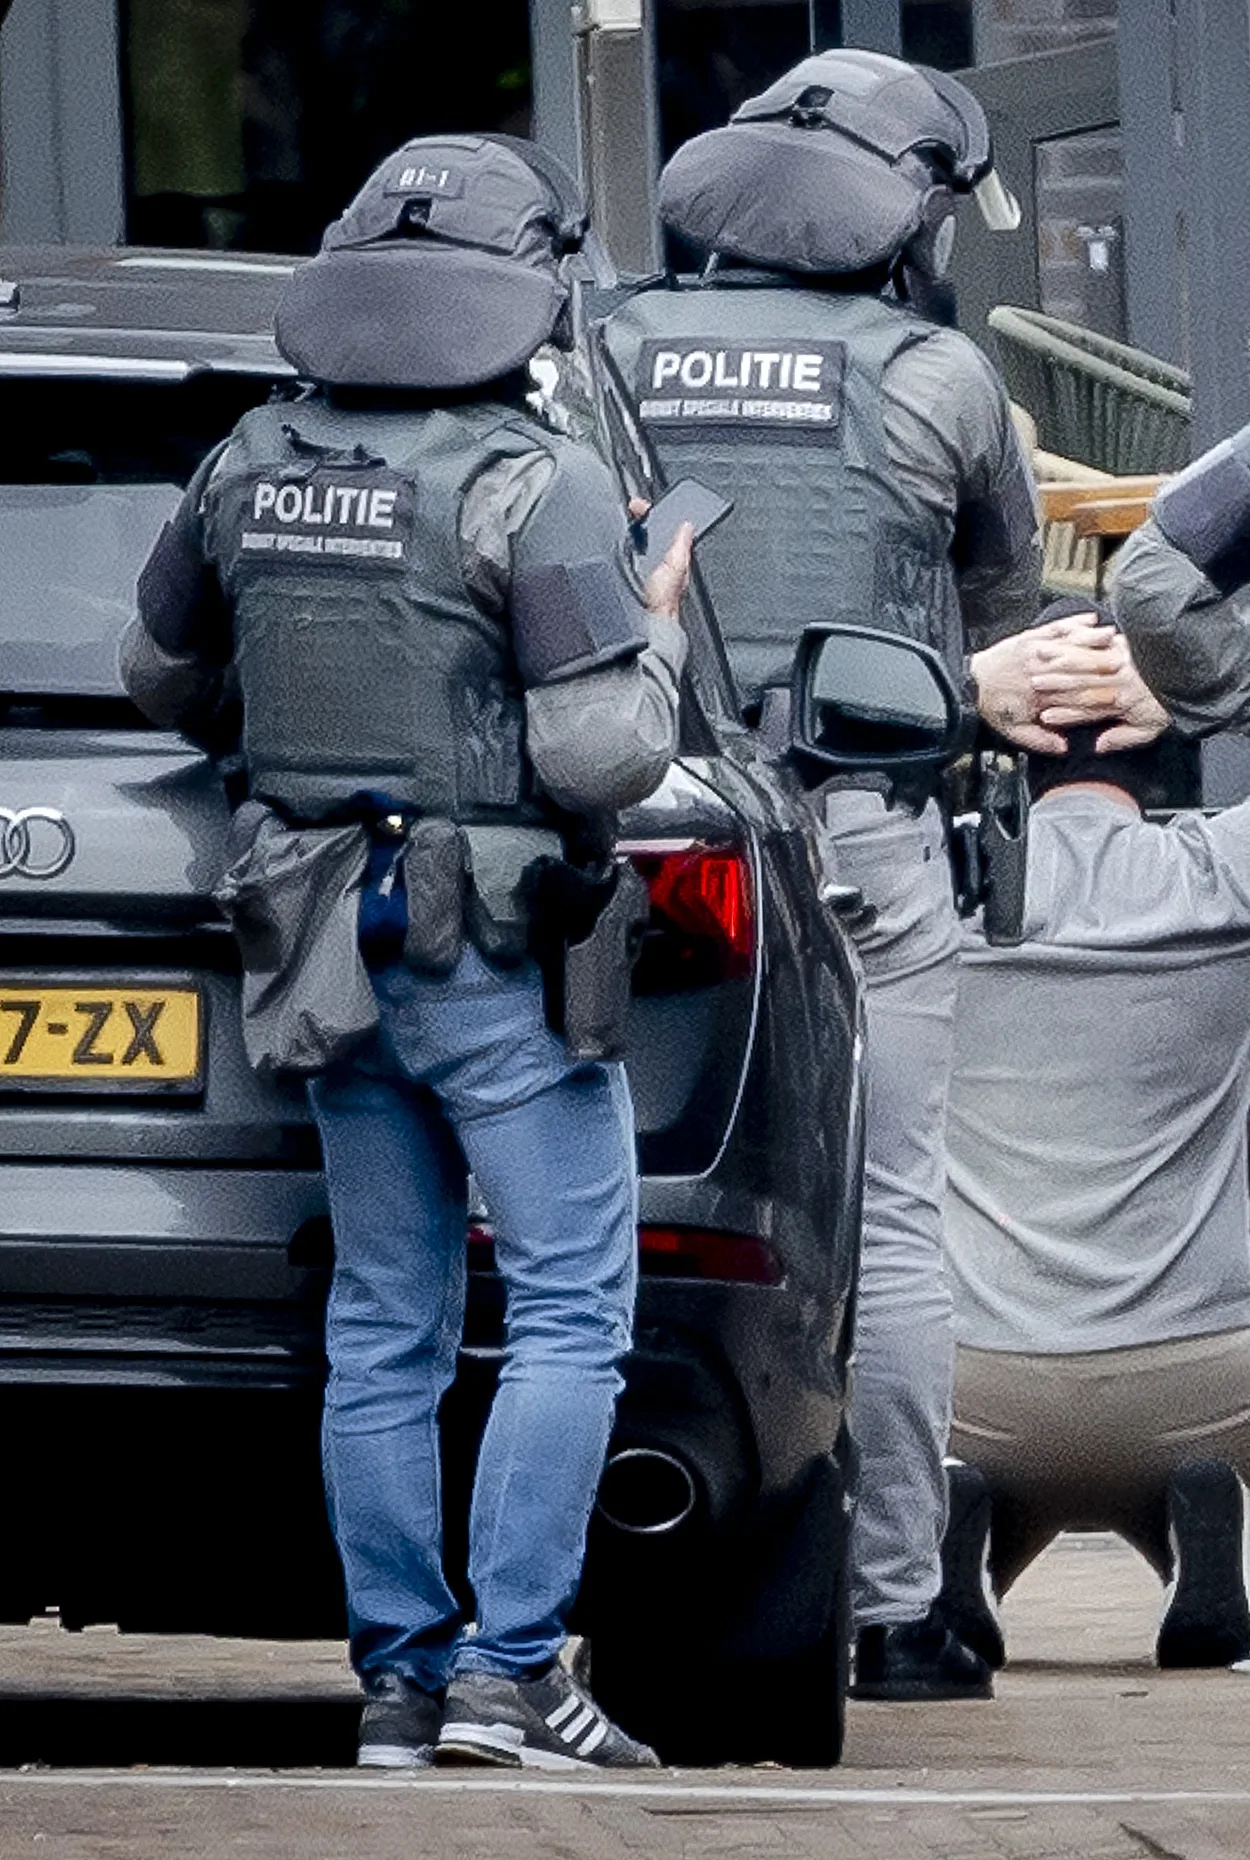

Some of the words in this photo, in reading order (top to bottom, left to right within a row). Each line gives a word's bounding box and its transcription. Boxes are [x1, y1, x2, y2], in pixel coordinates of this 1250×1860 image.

[652, 350, 824, 392] POLITIE
[253, 481, 398, 528] POLITIE
[0, 1000, 166, 1065] 7-ZX
